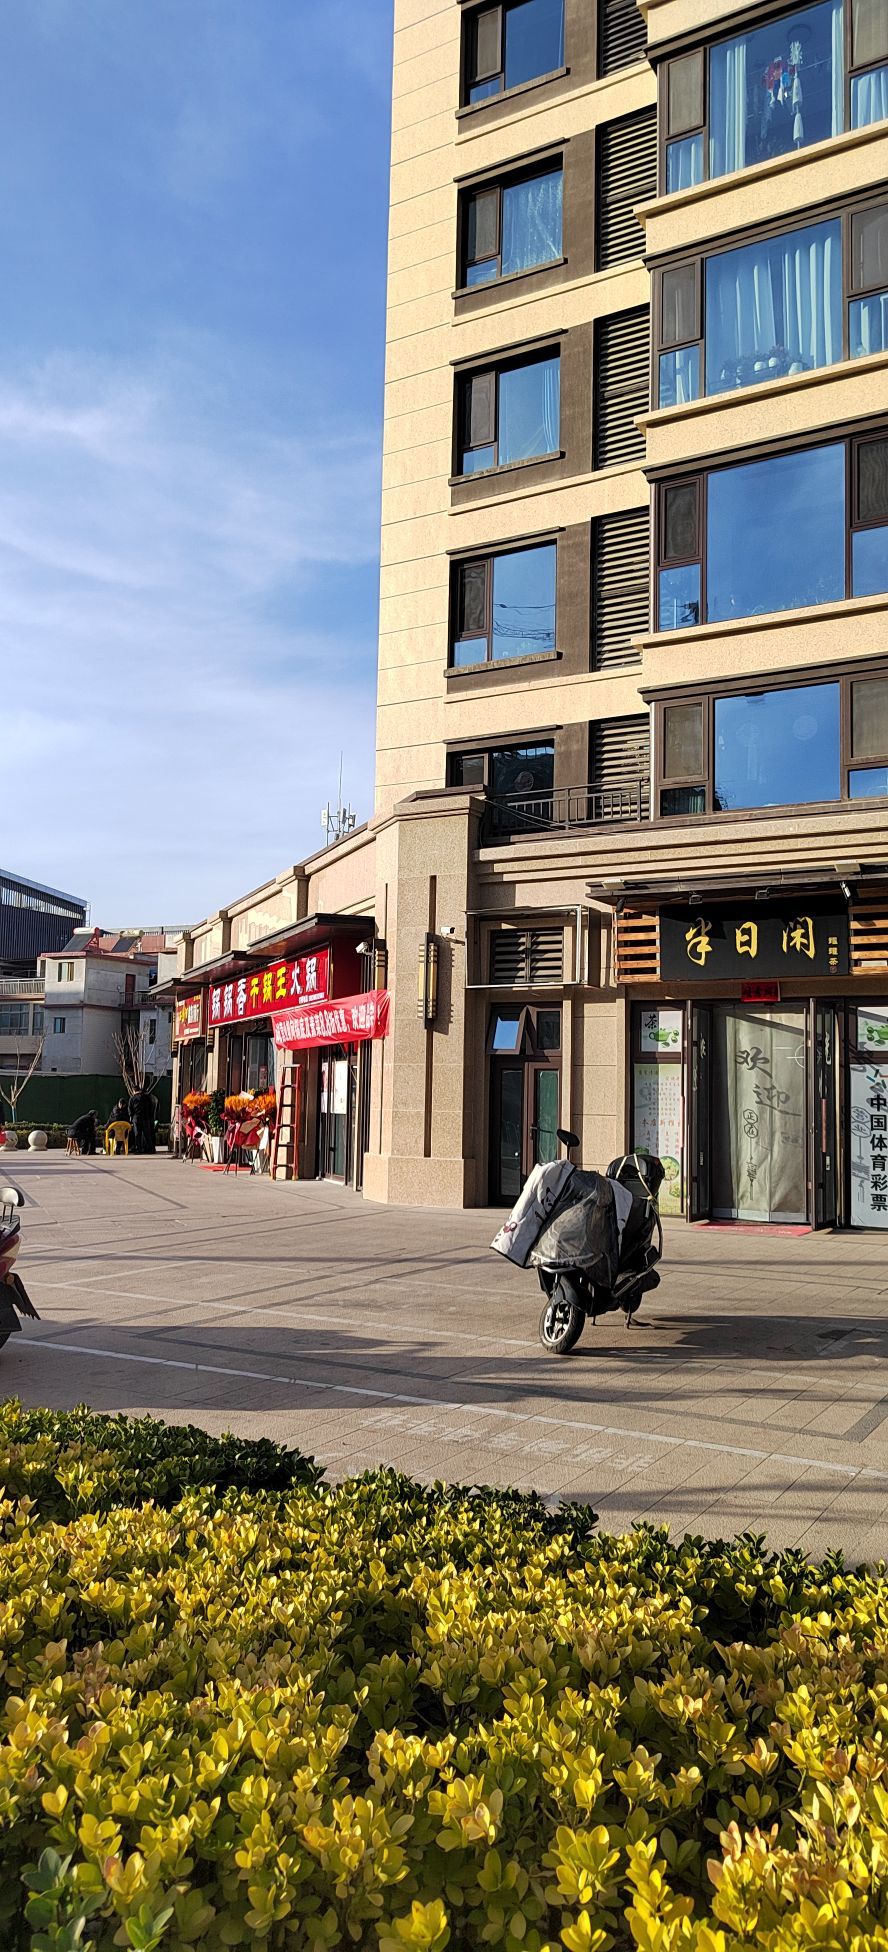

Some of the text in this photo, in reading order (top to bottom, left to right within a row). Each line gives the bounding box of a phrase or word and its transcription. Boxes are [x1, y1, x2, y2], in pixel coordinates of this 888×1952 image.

[685, 916, 815, 967] 半日闲
[644, 1014, 658, 1030] 茶
[869, 1094, 888, 1211] 中国体育彩票
